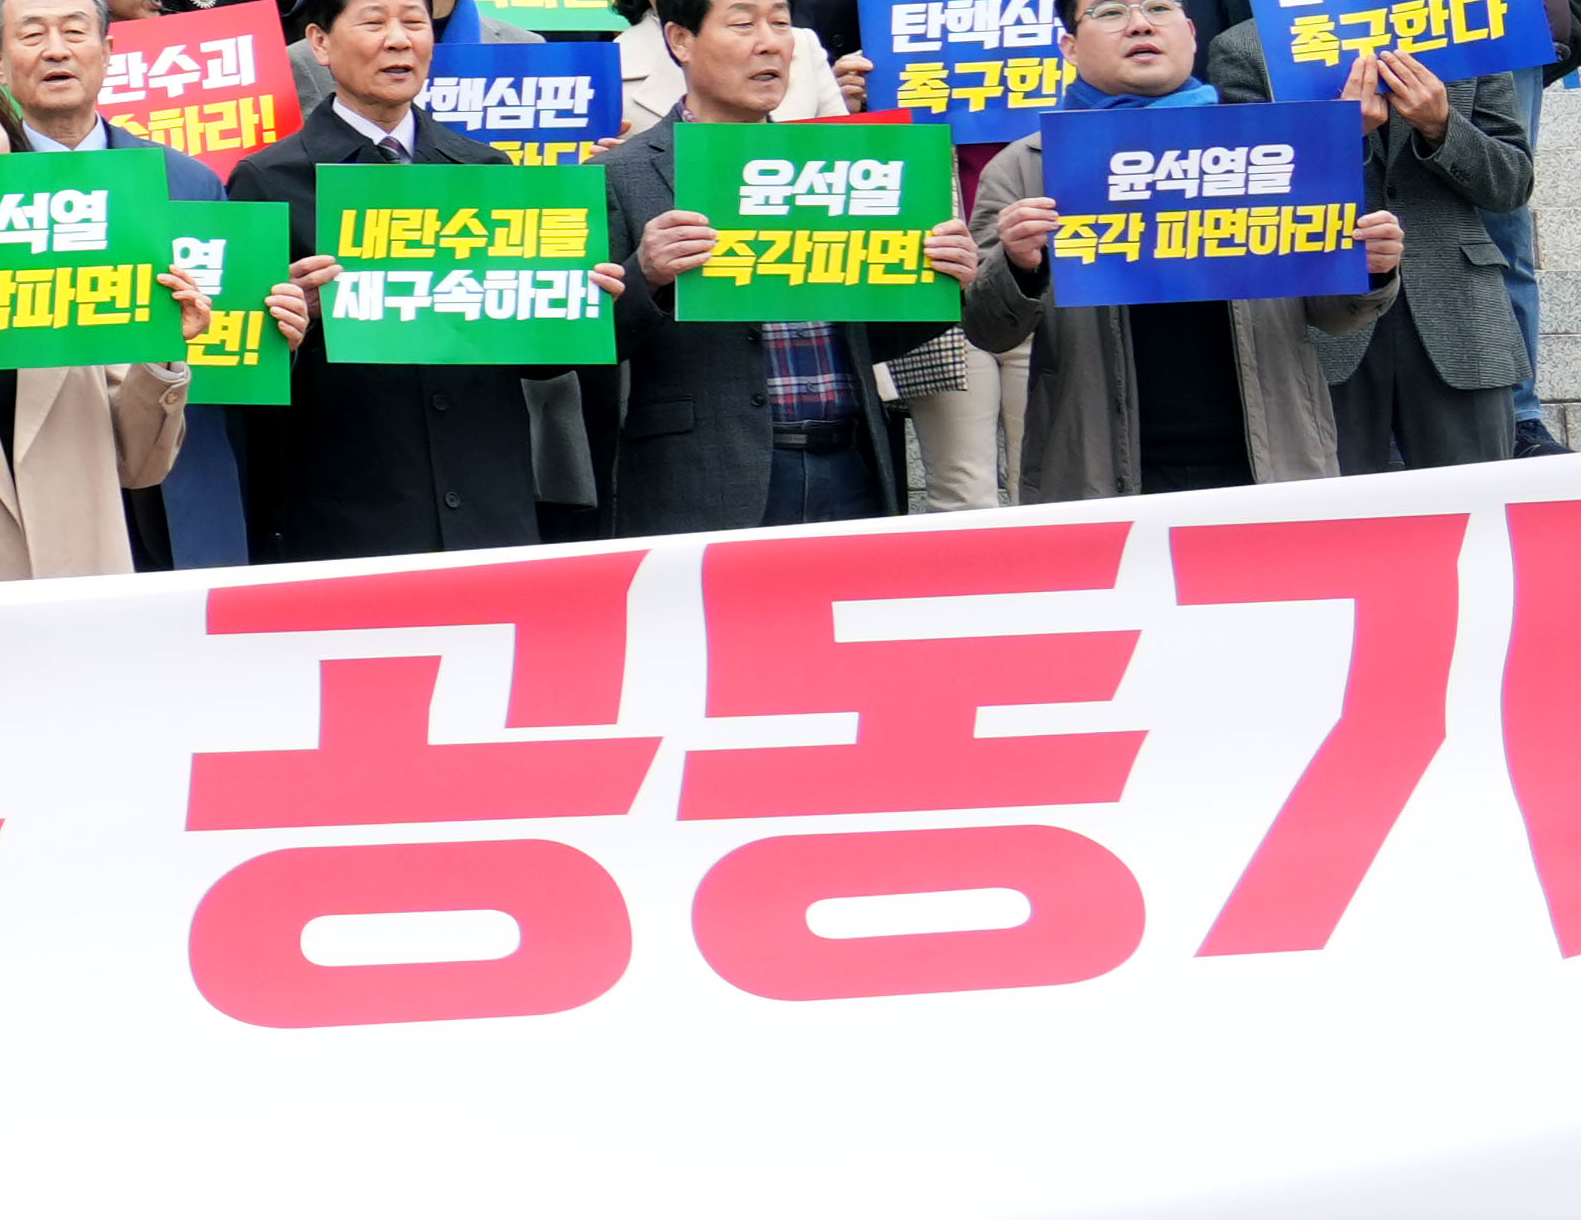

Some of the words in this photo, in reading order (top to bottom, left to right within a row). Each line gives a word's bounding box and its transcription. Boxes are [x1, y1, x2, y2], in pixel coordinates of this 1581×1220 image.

[891, 0, 1059, 53] 탄핵심
[103, 35, 255, 95] 란수괴
[899, 60, 1065, 115] 촉구한
[739, 158, 904, 217] 윤석열
[1108, 142, 1296, 200] 윤석열을
[338, 207, 589, 260] 내란수괴를
[704, 230, 934, 287] 즉각파면!
[1054, 213, 1145, 262] 즉각
[1155, 205, 1354, 261] 파면하라!
[332, 268, 600, 324] 재구속하라!
